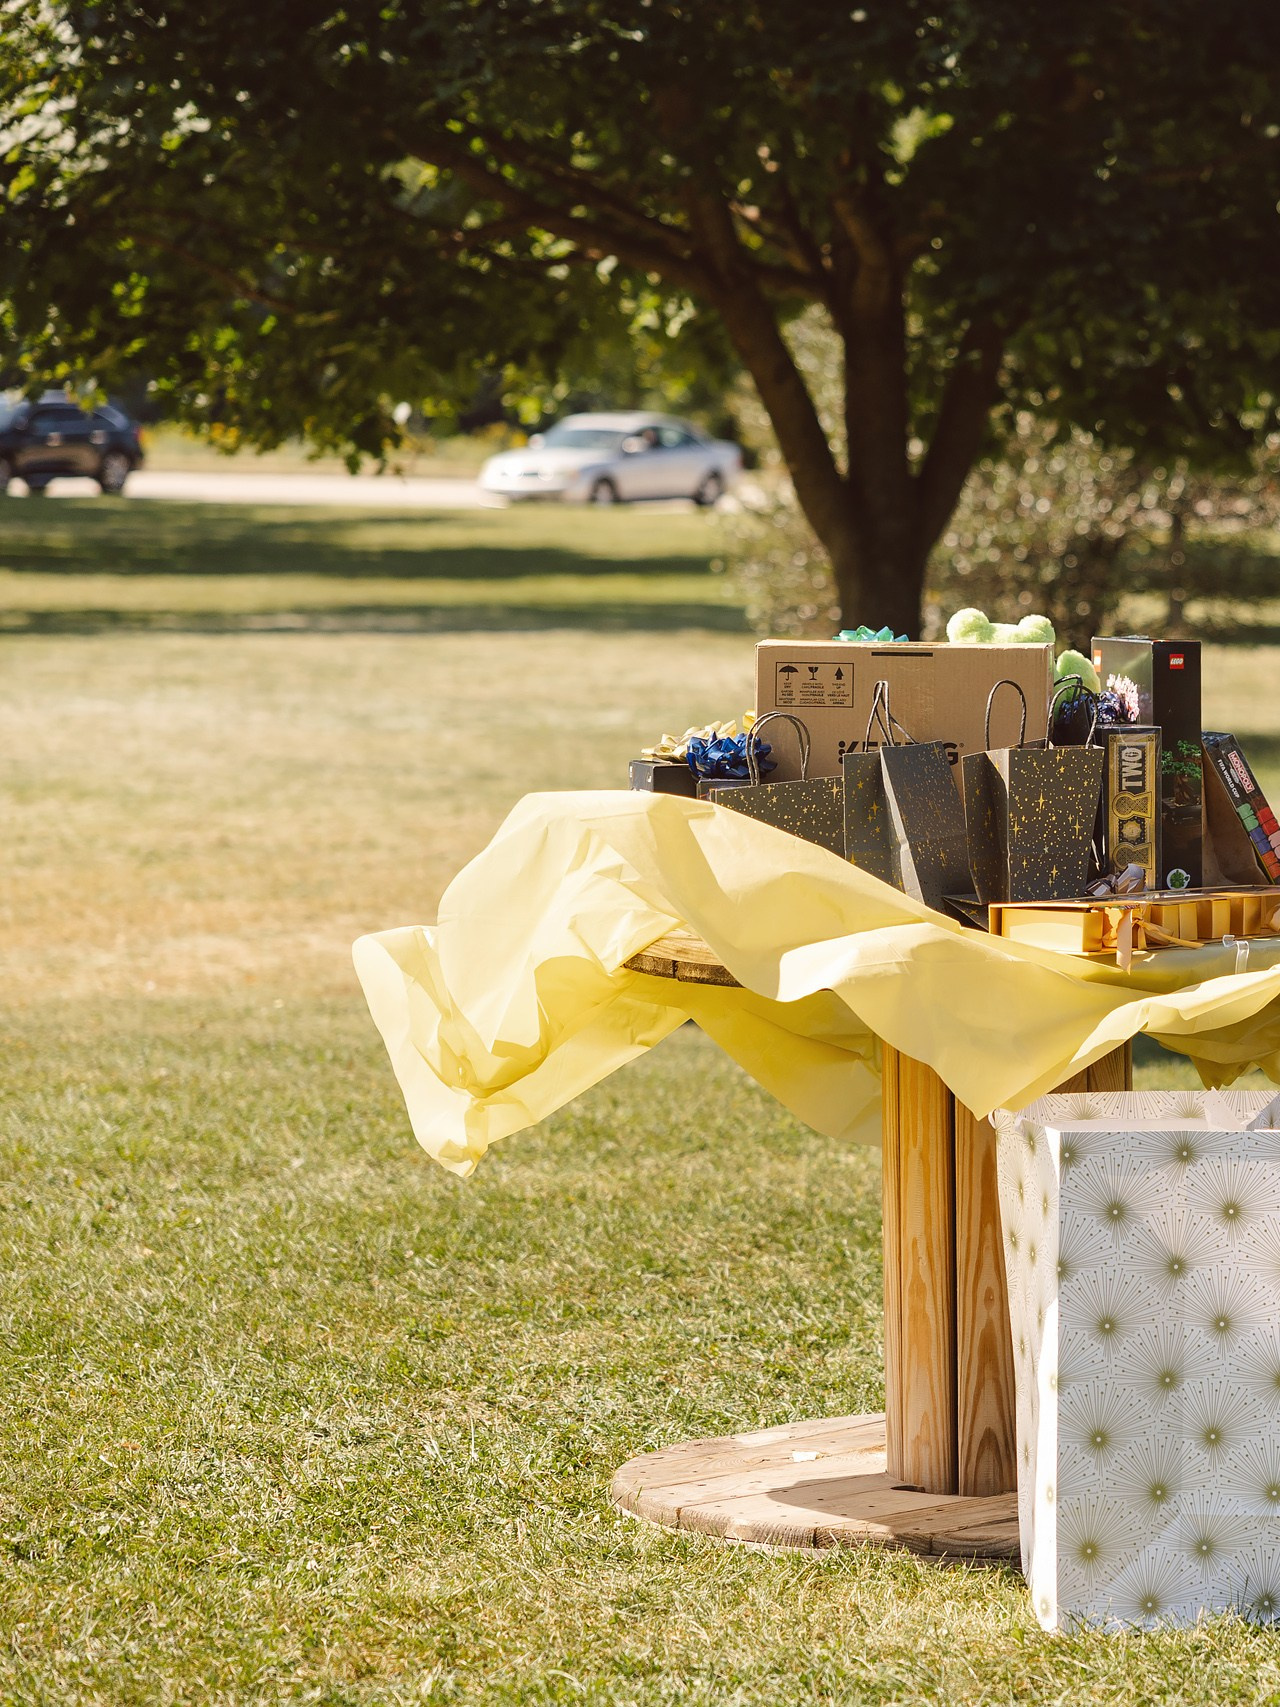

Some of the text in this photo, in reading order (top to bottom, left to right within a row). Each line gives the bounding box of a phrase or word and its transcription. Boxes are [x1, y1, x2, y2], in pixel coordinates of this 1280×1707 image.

[1170, 657, 1184, 666] LEGO
[1121, 747, 1143, 791] TWO
[1217, 759, 1226, 772] FIFA
[1223, 769, 1235, 789] WORLD
[1231, 787, 1240, 798] CUP
[1229, 752, 1254, 792] MONOPOLY
